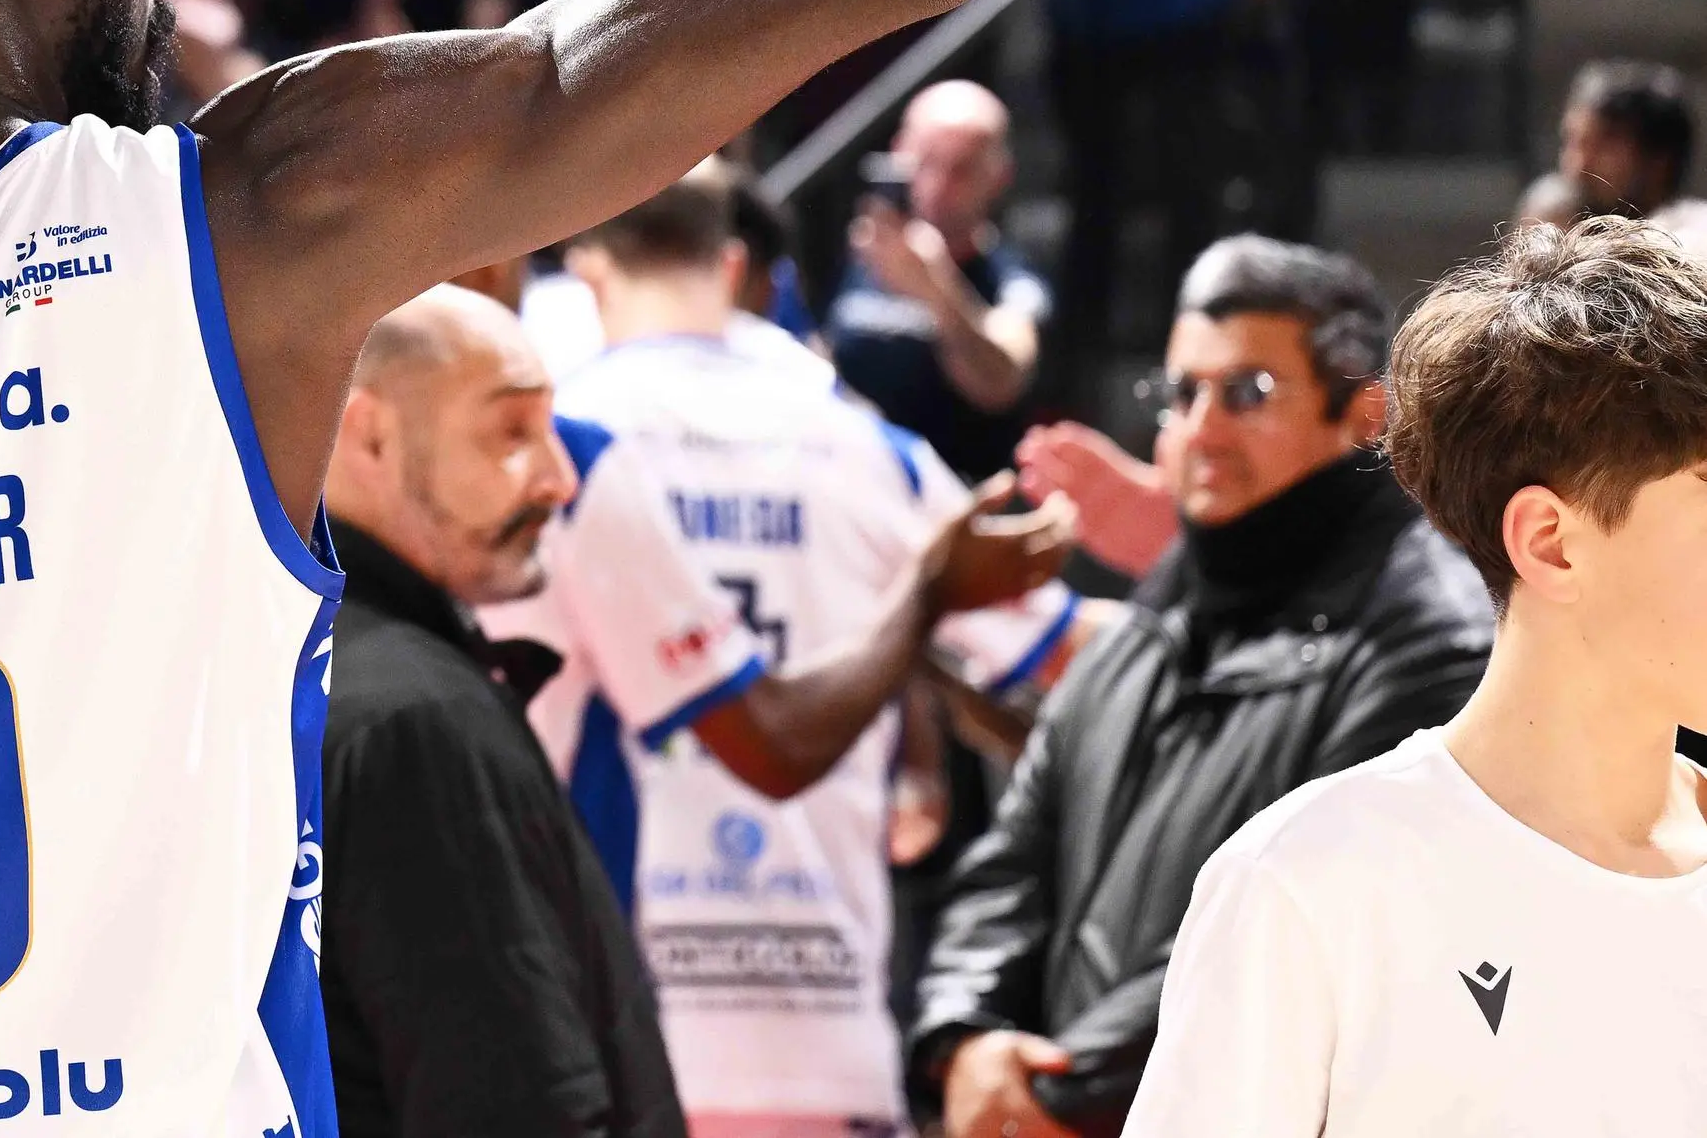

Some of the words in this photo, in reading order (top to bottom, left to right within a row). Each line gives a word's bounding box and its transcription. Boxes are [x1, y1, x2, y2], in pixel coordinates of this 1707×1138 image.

[43, 225, 81, 238] Valore
[57, 236, 68, 247] in
[70, 225, 108, 245] edilizia
[6, 284, 53, 308] GROUP
